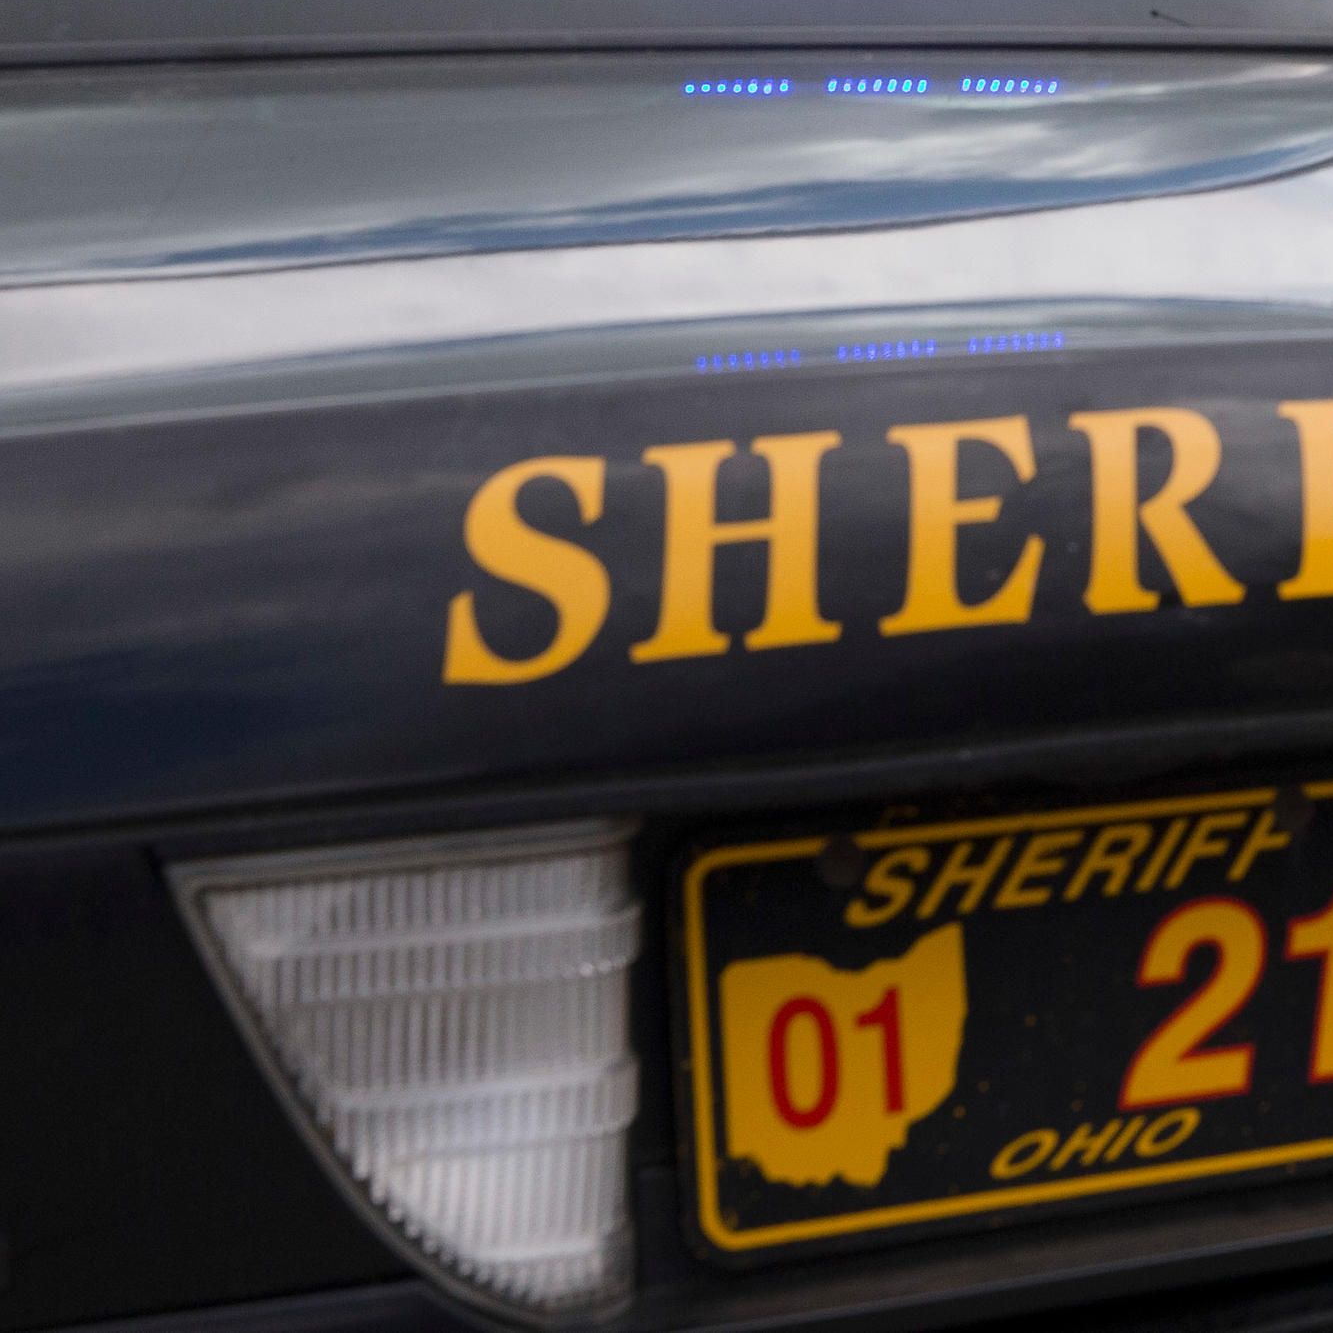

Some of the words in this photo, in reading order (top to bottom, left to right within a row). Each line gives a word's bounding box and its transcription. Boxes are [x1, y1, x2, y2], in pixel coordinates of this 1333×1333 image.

[844, 812, 1291, 929] SHERIFF
[768, 987, 905, 1131] 01
[989, 1107, 1201, 1180] OHIO
